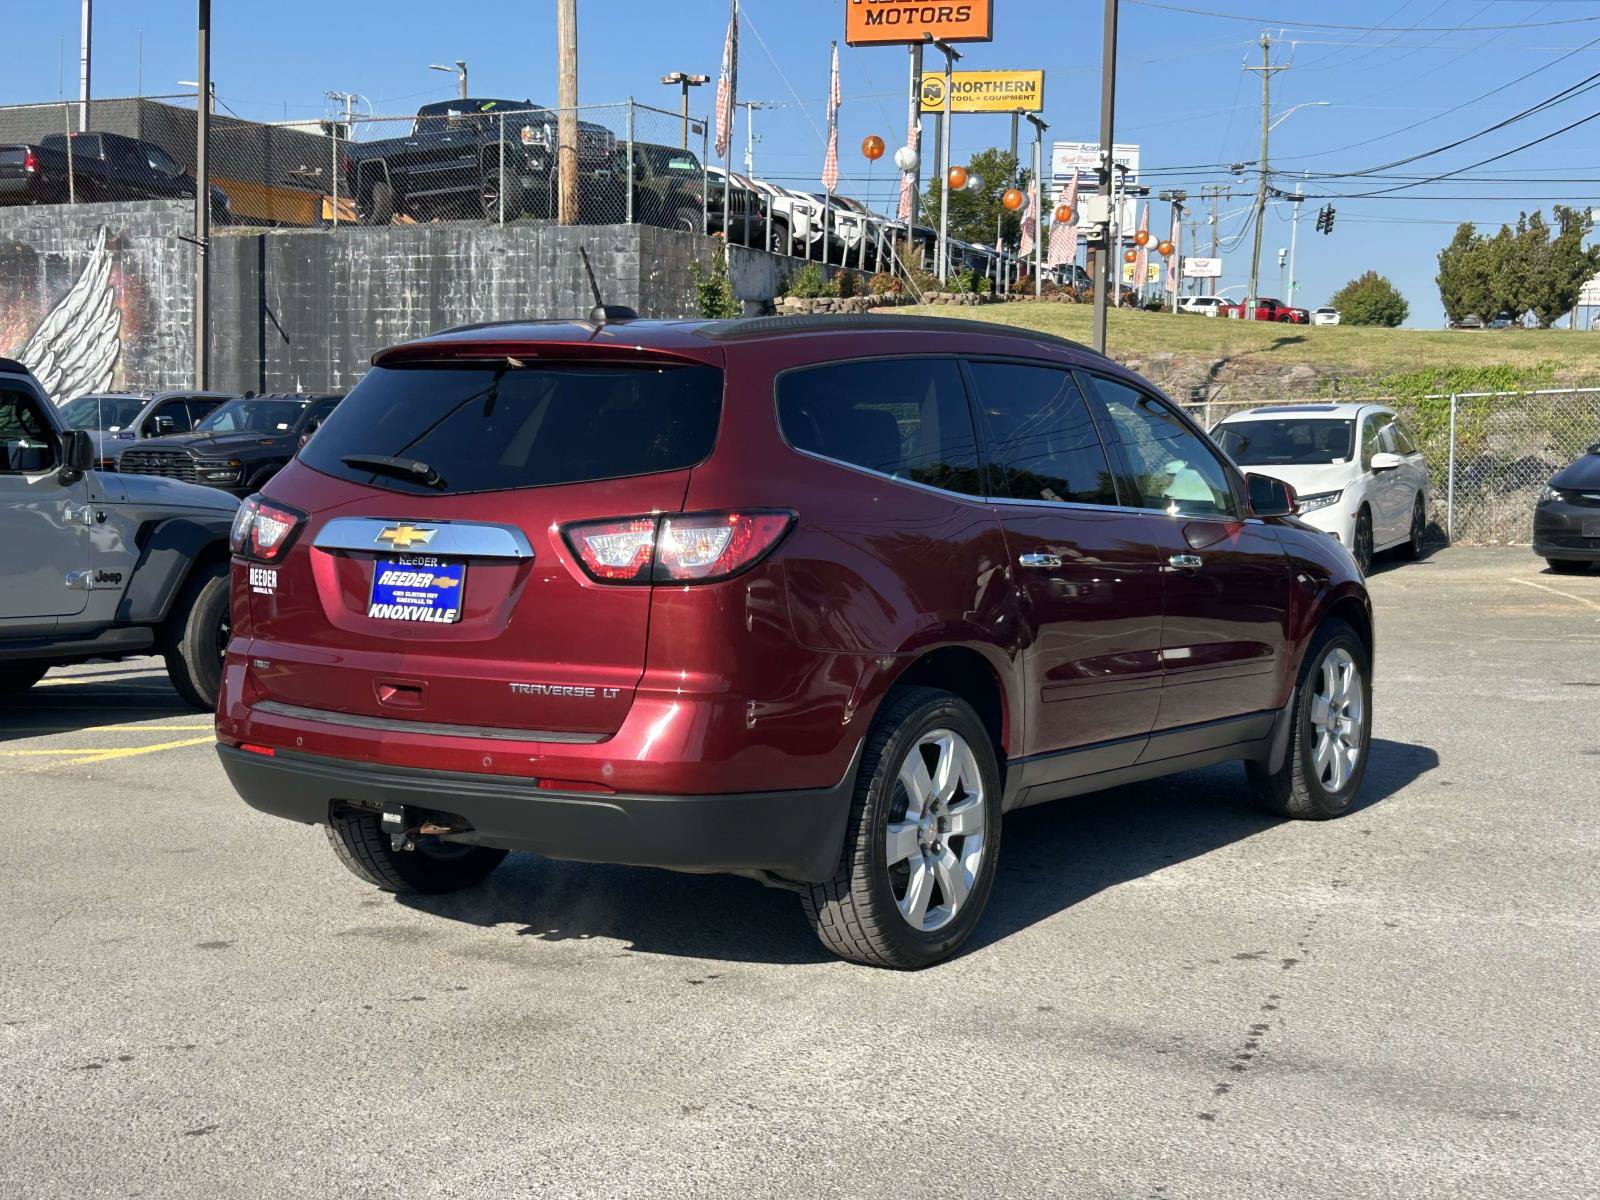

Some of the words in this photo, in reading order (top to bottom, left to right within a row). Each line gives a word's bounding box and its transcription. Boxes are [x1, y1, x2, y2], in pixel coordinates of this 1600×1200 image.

[865, 6, 971, 25] MOTORS
[950, 81, 1036, 93] NORTHERN
[399, 556, 438, 567] REEDER
[95, 570, 122, 584] Jeep
[250, 568, 277, 588] REEDER
[378, 571, 434, 588] REEDER
[368, 603, 457, 623] KNOXVILLE
[509, 683, 595, 698] TRAVERSE
[603, 688, 620, 698] LT
